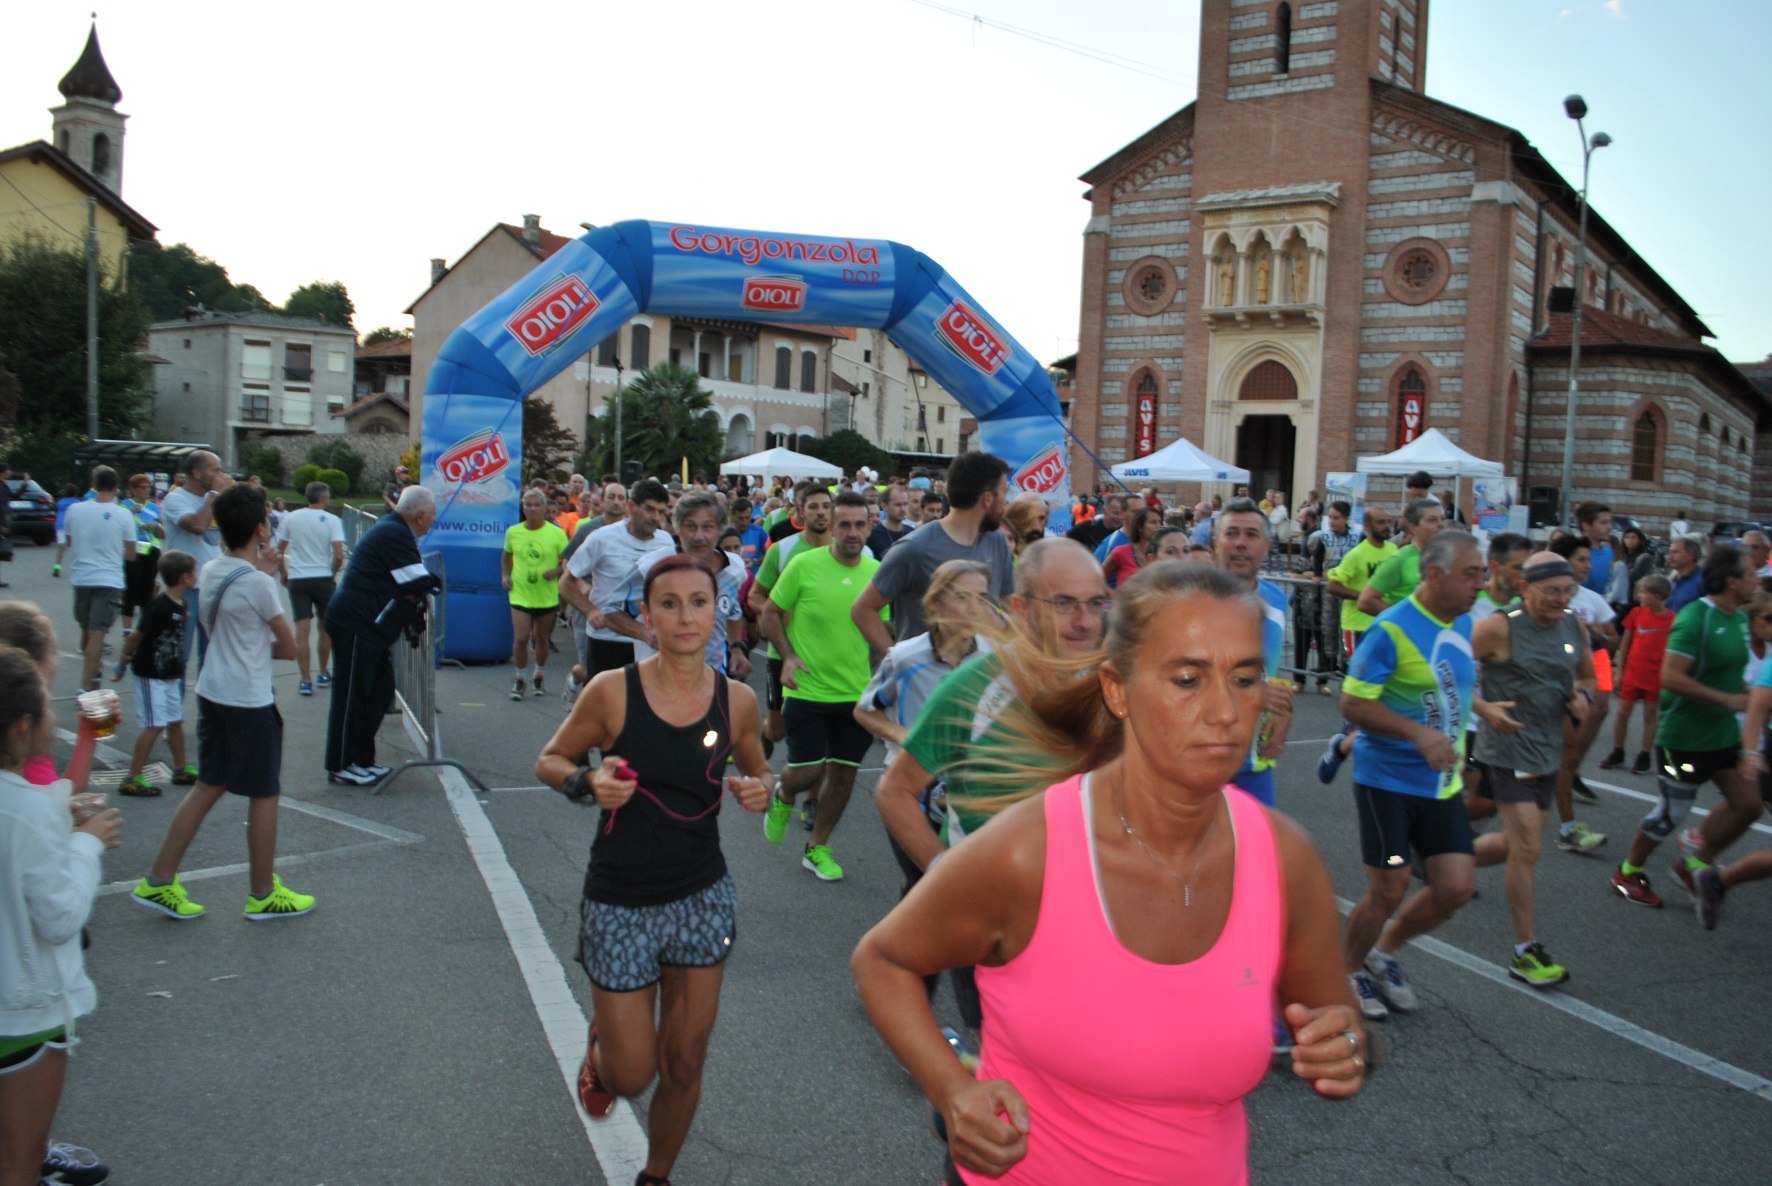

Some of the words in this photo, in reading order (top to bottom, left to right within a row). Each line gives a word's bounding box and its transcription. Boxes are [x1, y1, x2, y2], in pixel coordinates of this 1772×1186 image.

[668, 225, 880, 266] Gorgonzola
[521, 285, 590, 342] OIOLI
[748, 287, 800, 305] OIOLI
[948, 311, 1003, 366] OIOLI
[1140, 399, 1152, 451] AVIS
[1404, 399, 1419, 443] AVI
[446, 442, 505, 480] OIOLI
[1023, 455, 1063, 492] OIOLI
[1124, 468, 1149, 476] AVIS
